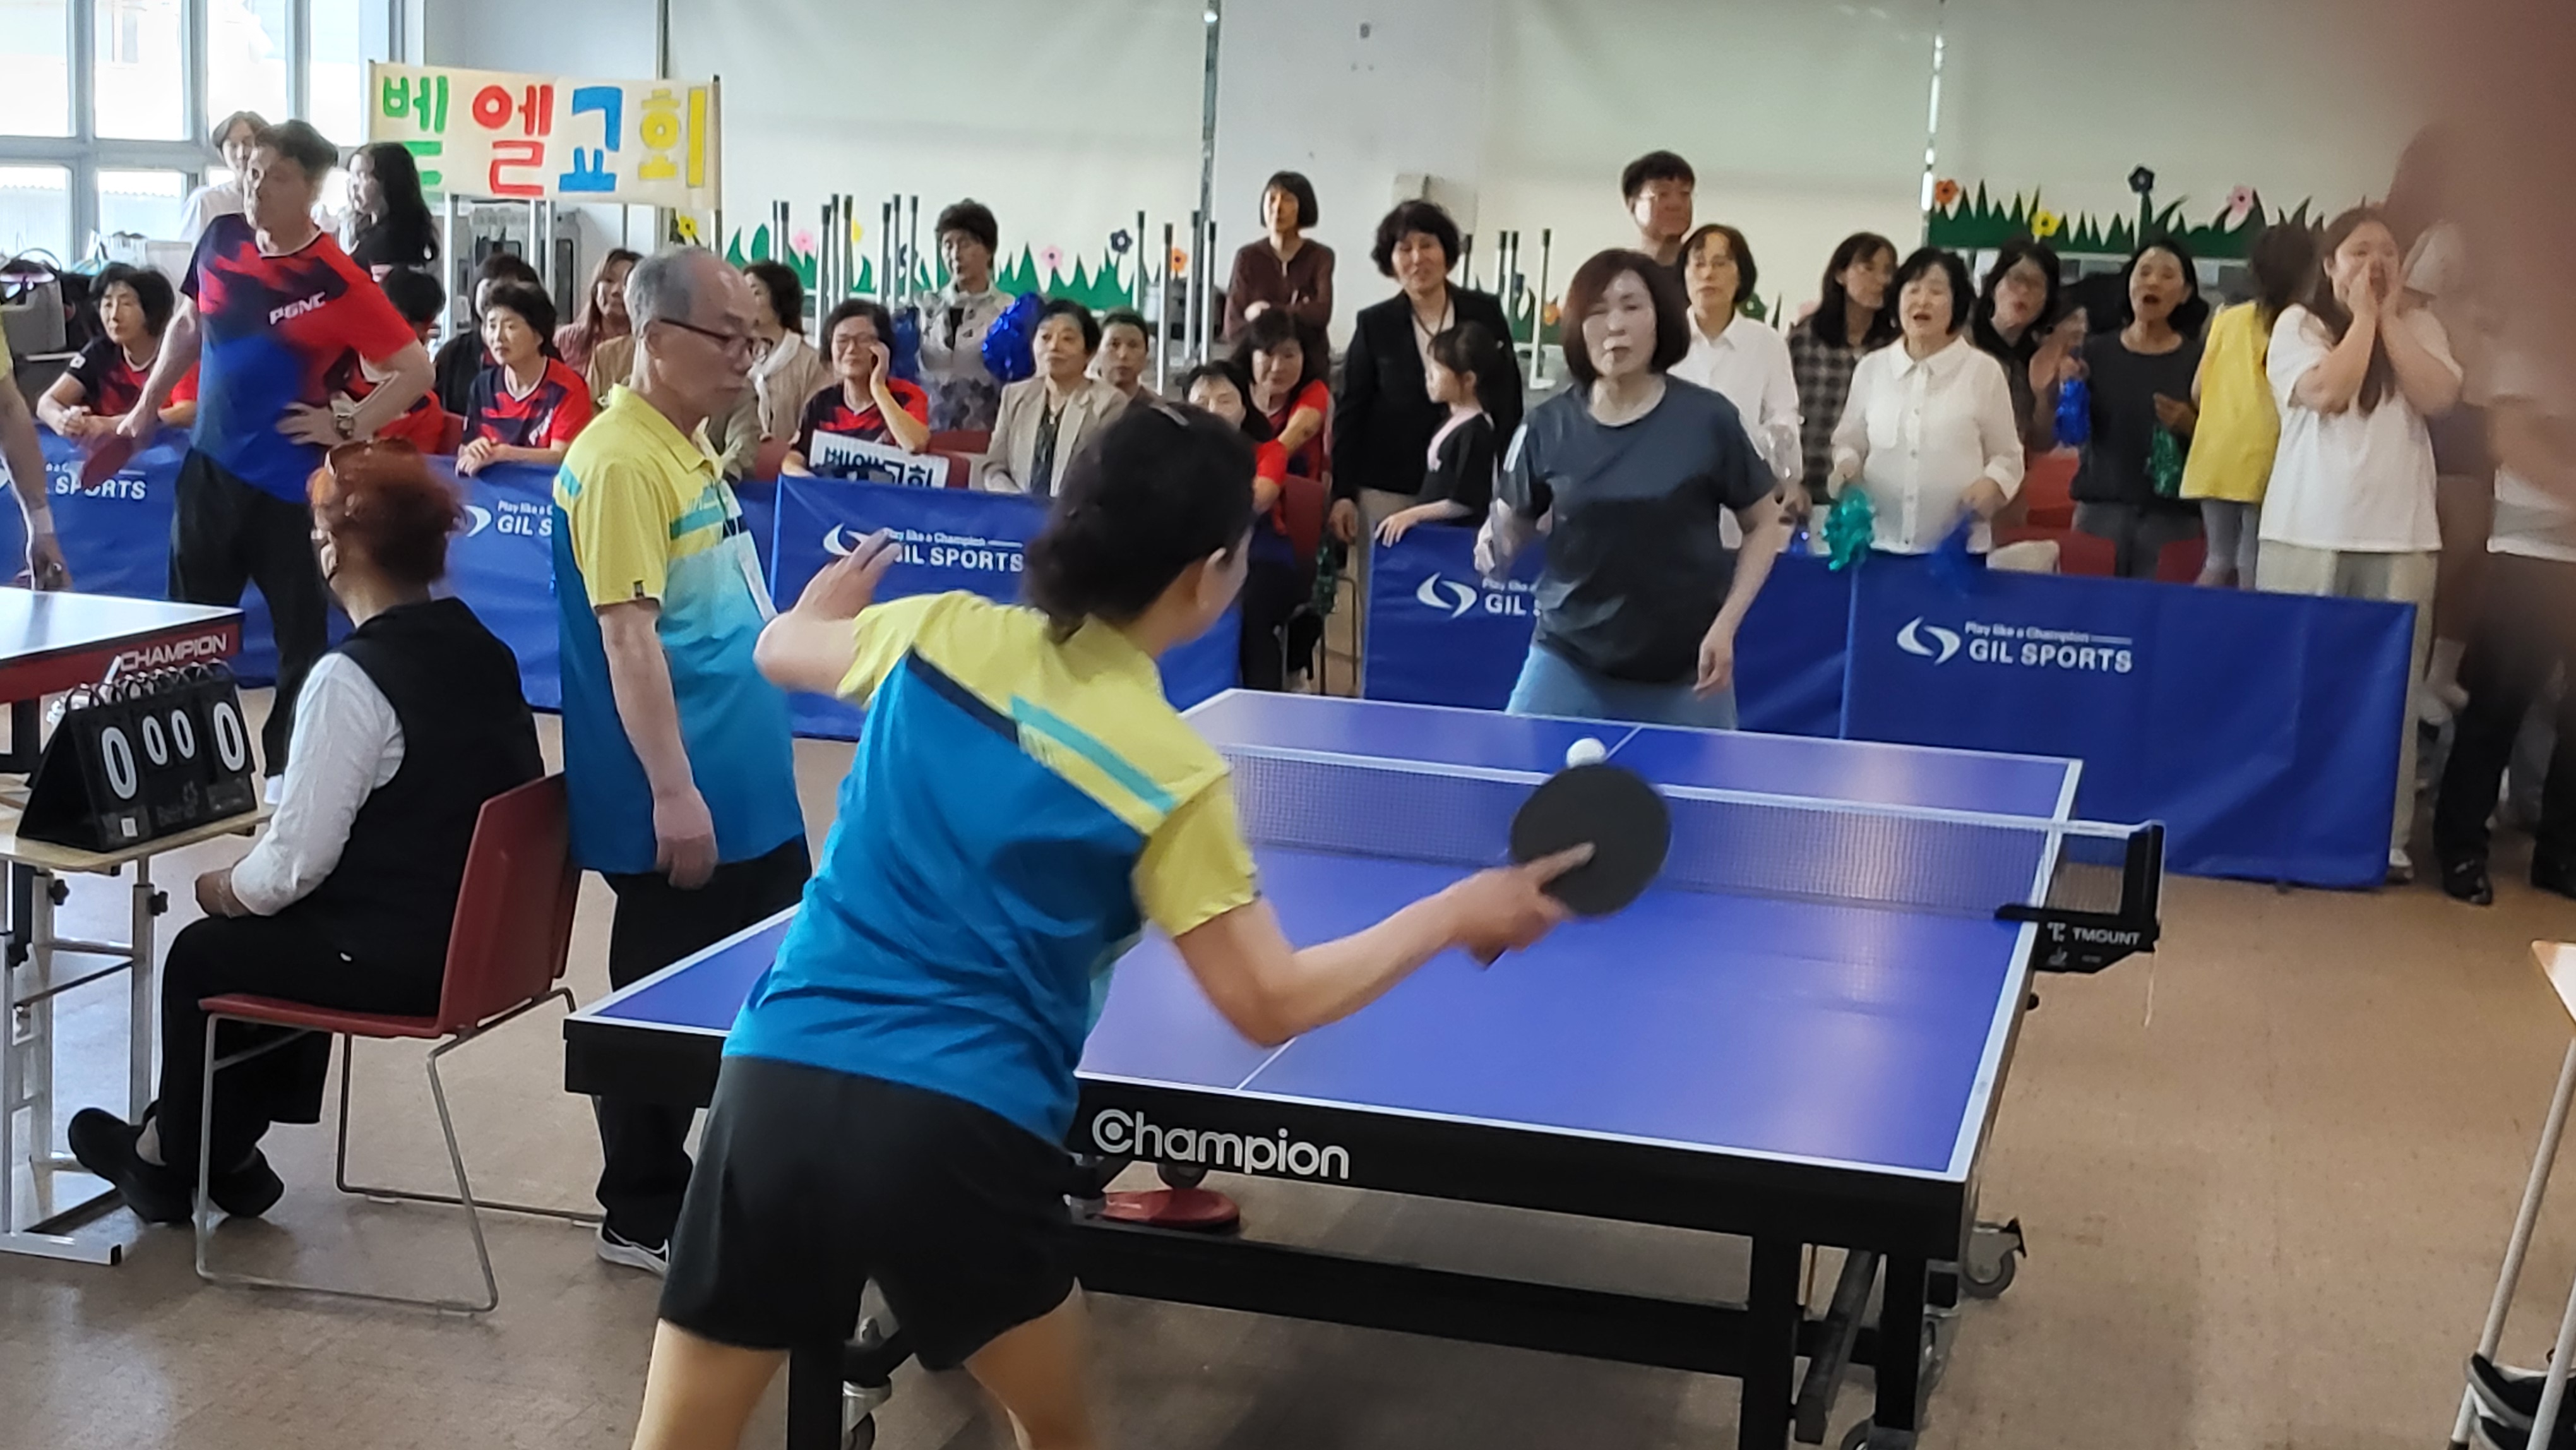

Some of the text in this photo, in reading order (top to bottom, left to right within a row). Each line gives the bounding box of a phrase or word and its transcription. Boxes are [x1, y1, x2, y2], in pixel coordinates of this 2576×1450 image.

[270, 291, 326, 325] PGNC
[498, 515, 533, 535] GIL
[930, 546, 1024, 572] SPORTS
[1485, 594, 1527, 616] GIL
[120, 633, 227, 671] CHAMPION
[1969, 638, 2132, 673] GIL SPORTS
[102, 727, 137, 800] 0
[213, 702, 246, 771] 0
[2073, 927, 2140, 945] TMOUNT
[1092, 1108, 1349, 1180] Champion
